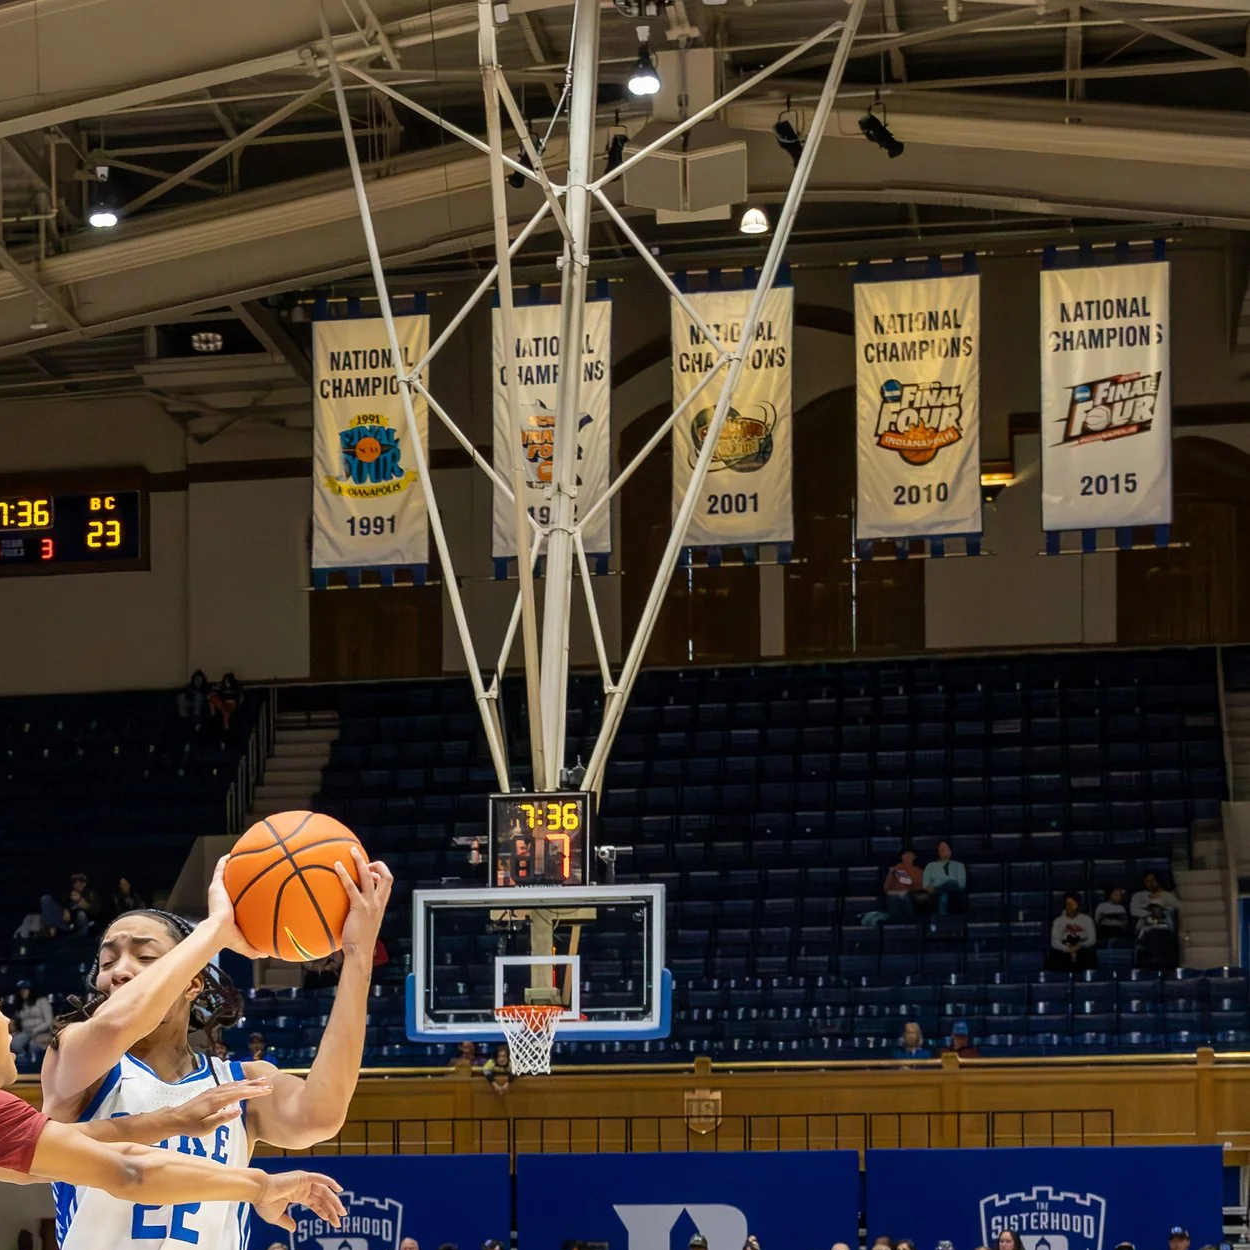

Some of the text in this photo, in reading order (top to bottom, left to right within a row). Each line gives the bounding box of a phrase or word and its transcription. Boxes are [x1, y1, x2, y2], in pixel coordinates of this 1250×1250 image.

[873, 308, 962, 335] NATIONAL
[1060, 296, 1151, 323] NATIONAL
[864, 336, 973, 364] CHAMPIONS
[1048, 323, 1163, 352] CHAMPIONS
[330, 346, 414, 372] NATIONL
[900, 384, 960, 409] FINAL
[357, 414, 380, 425] 1991
[876, 401, 962, 436] FOUR
[338, 425, 400, 450] FINAL
[893, 482, 949, 506] 2010
[1080, 473, 1138, 496] 2015
[706, 492, 759, 515] 2001
[87, 520, 121, 547] 23
[346, 514, 397, 537] 1991
[41, 538, 53, 558] 3
[520, 802, 580, 830] 7:36
[545, 833, 571, 880] 7
[111, 1112, 231, 1165] KE
[297, 1215, 393, 1242] SISTRHOOD
[991, 1211, 1095, 1240] SISTERHOOD
